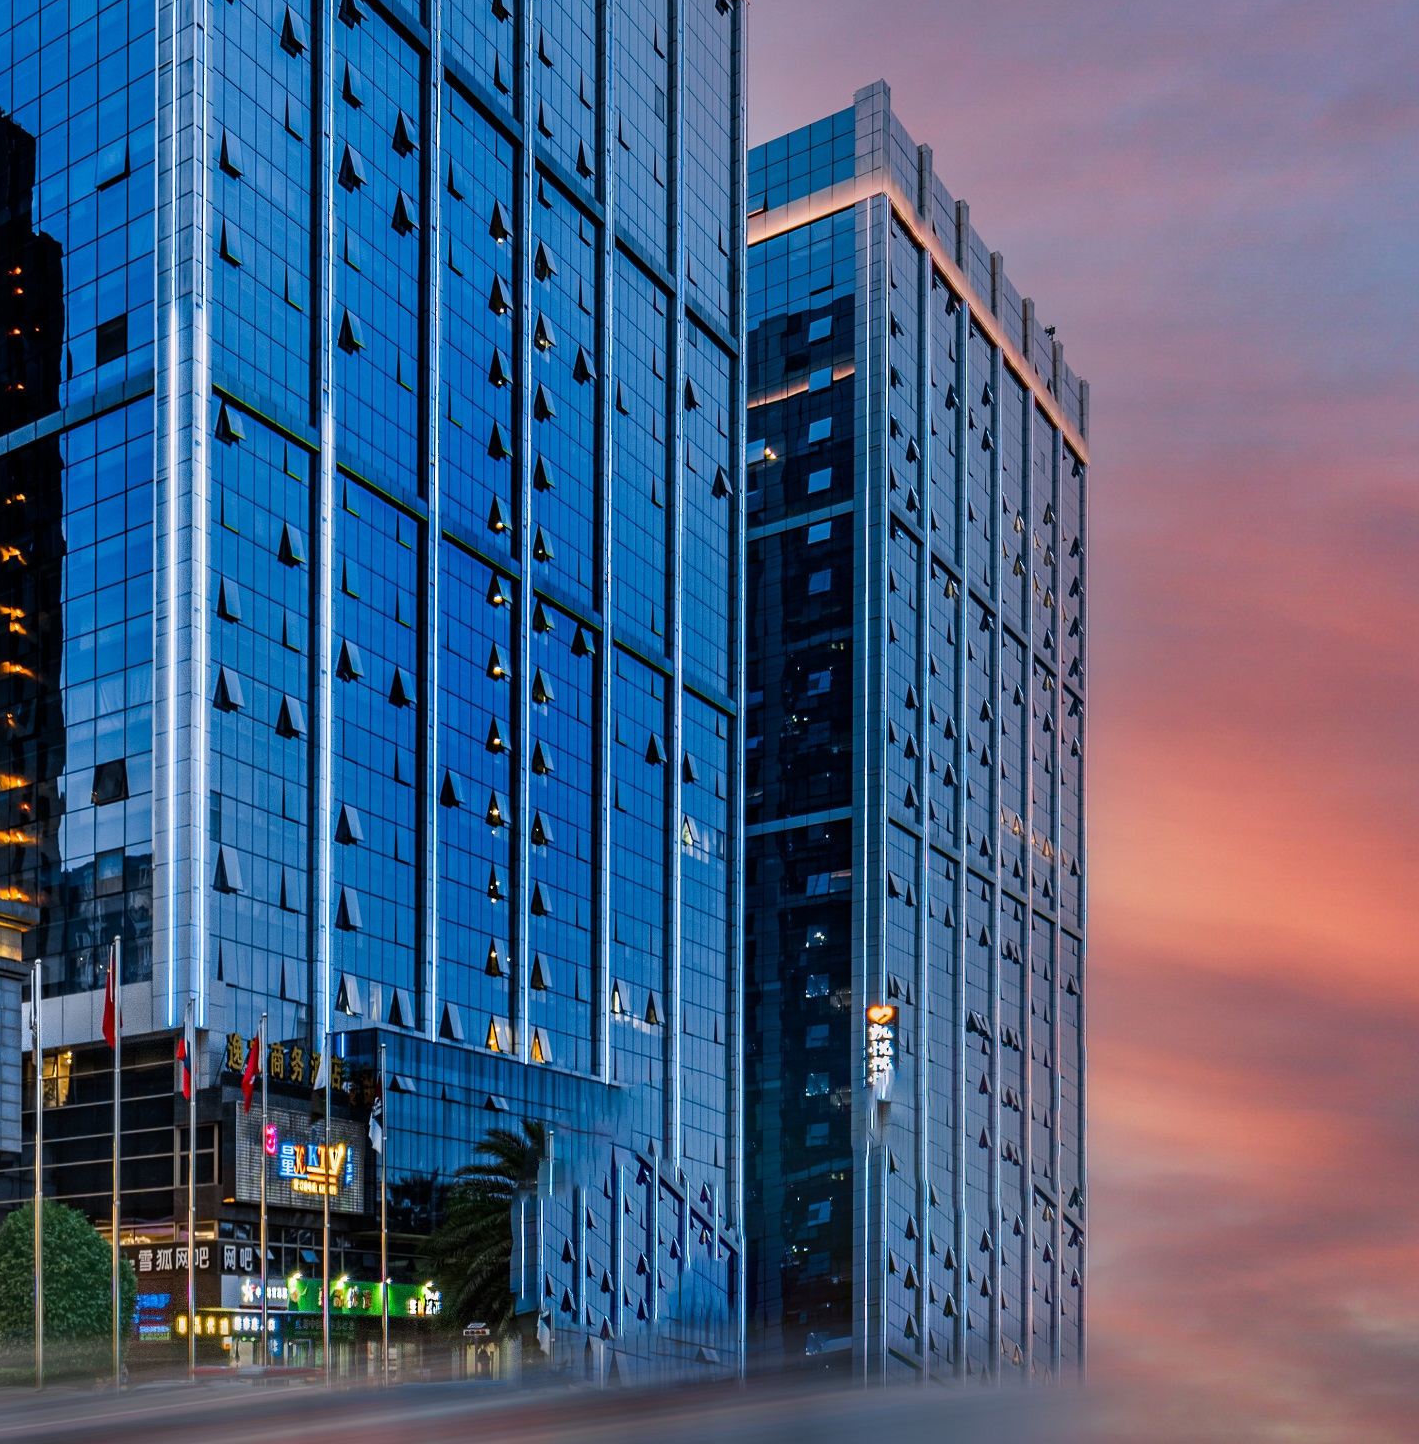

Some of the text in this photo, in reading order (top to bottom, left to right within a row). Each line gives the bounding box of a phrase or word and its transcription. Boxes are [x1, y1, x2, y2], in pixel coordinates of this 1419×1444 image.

[139, 1246, 209, 1271] 雪狐网吧
[224, 1245, 253, 1271] 网吧
